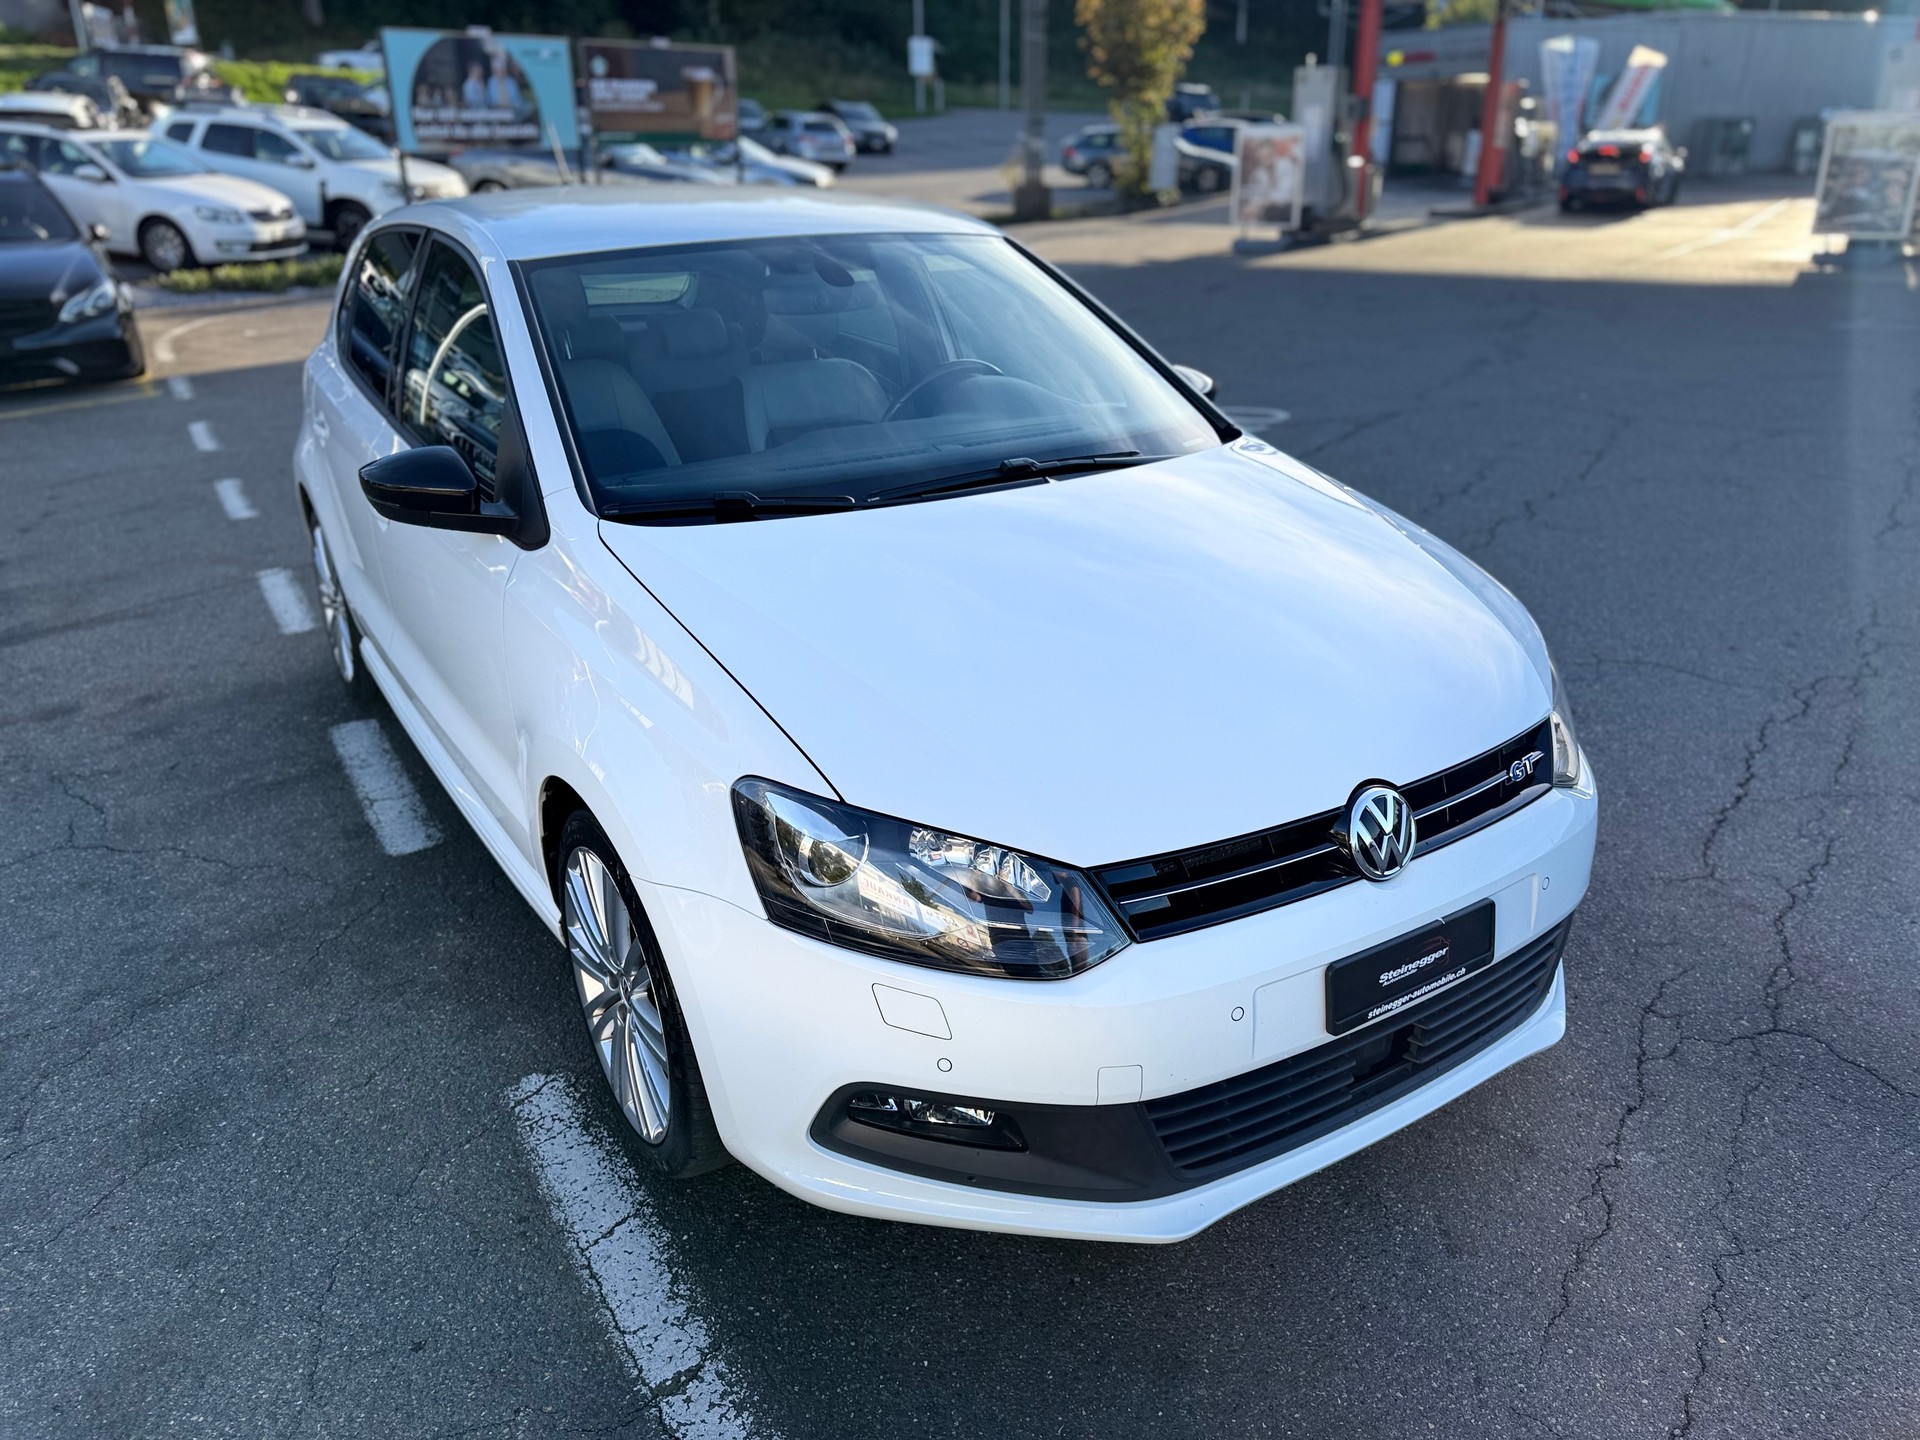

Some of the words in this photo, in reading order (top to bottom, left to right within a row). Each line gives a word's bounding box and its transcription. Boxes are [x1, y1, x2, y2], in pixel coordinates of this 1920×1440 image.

[1510, 751, 1534, 782] GT
[1351, 788, 1415, 880] VW
[1379, 947, 1449, 984] Steinegger
[1368, 966, 1467, 1020] steinegger-automobile.ch
